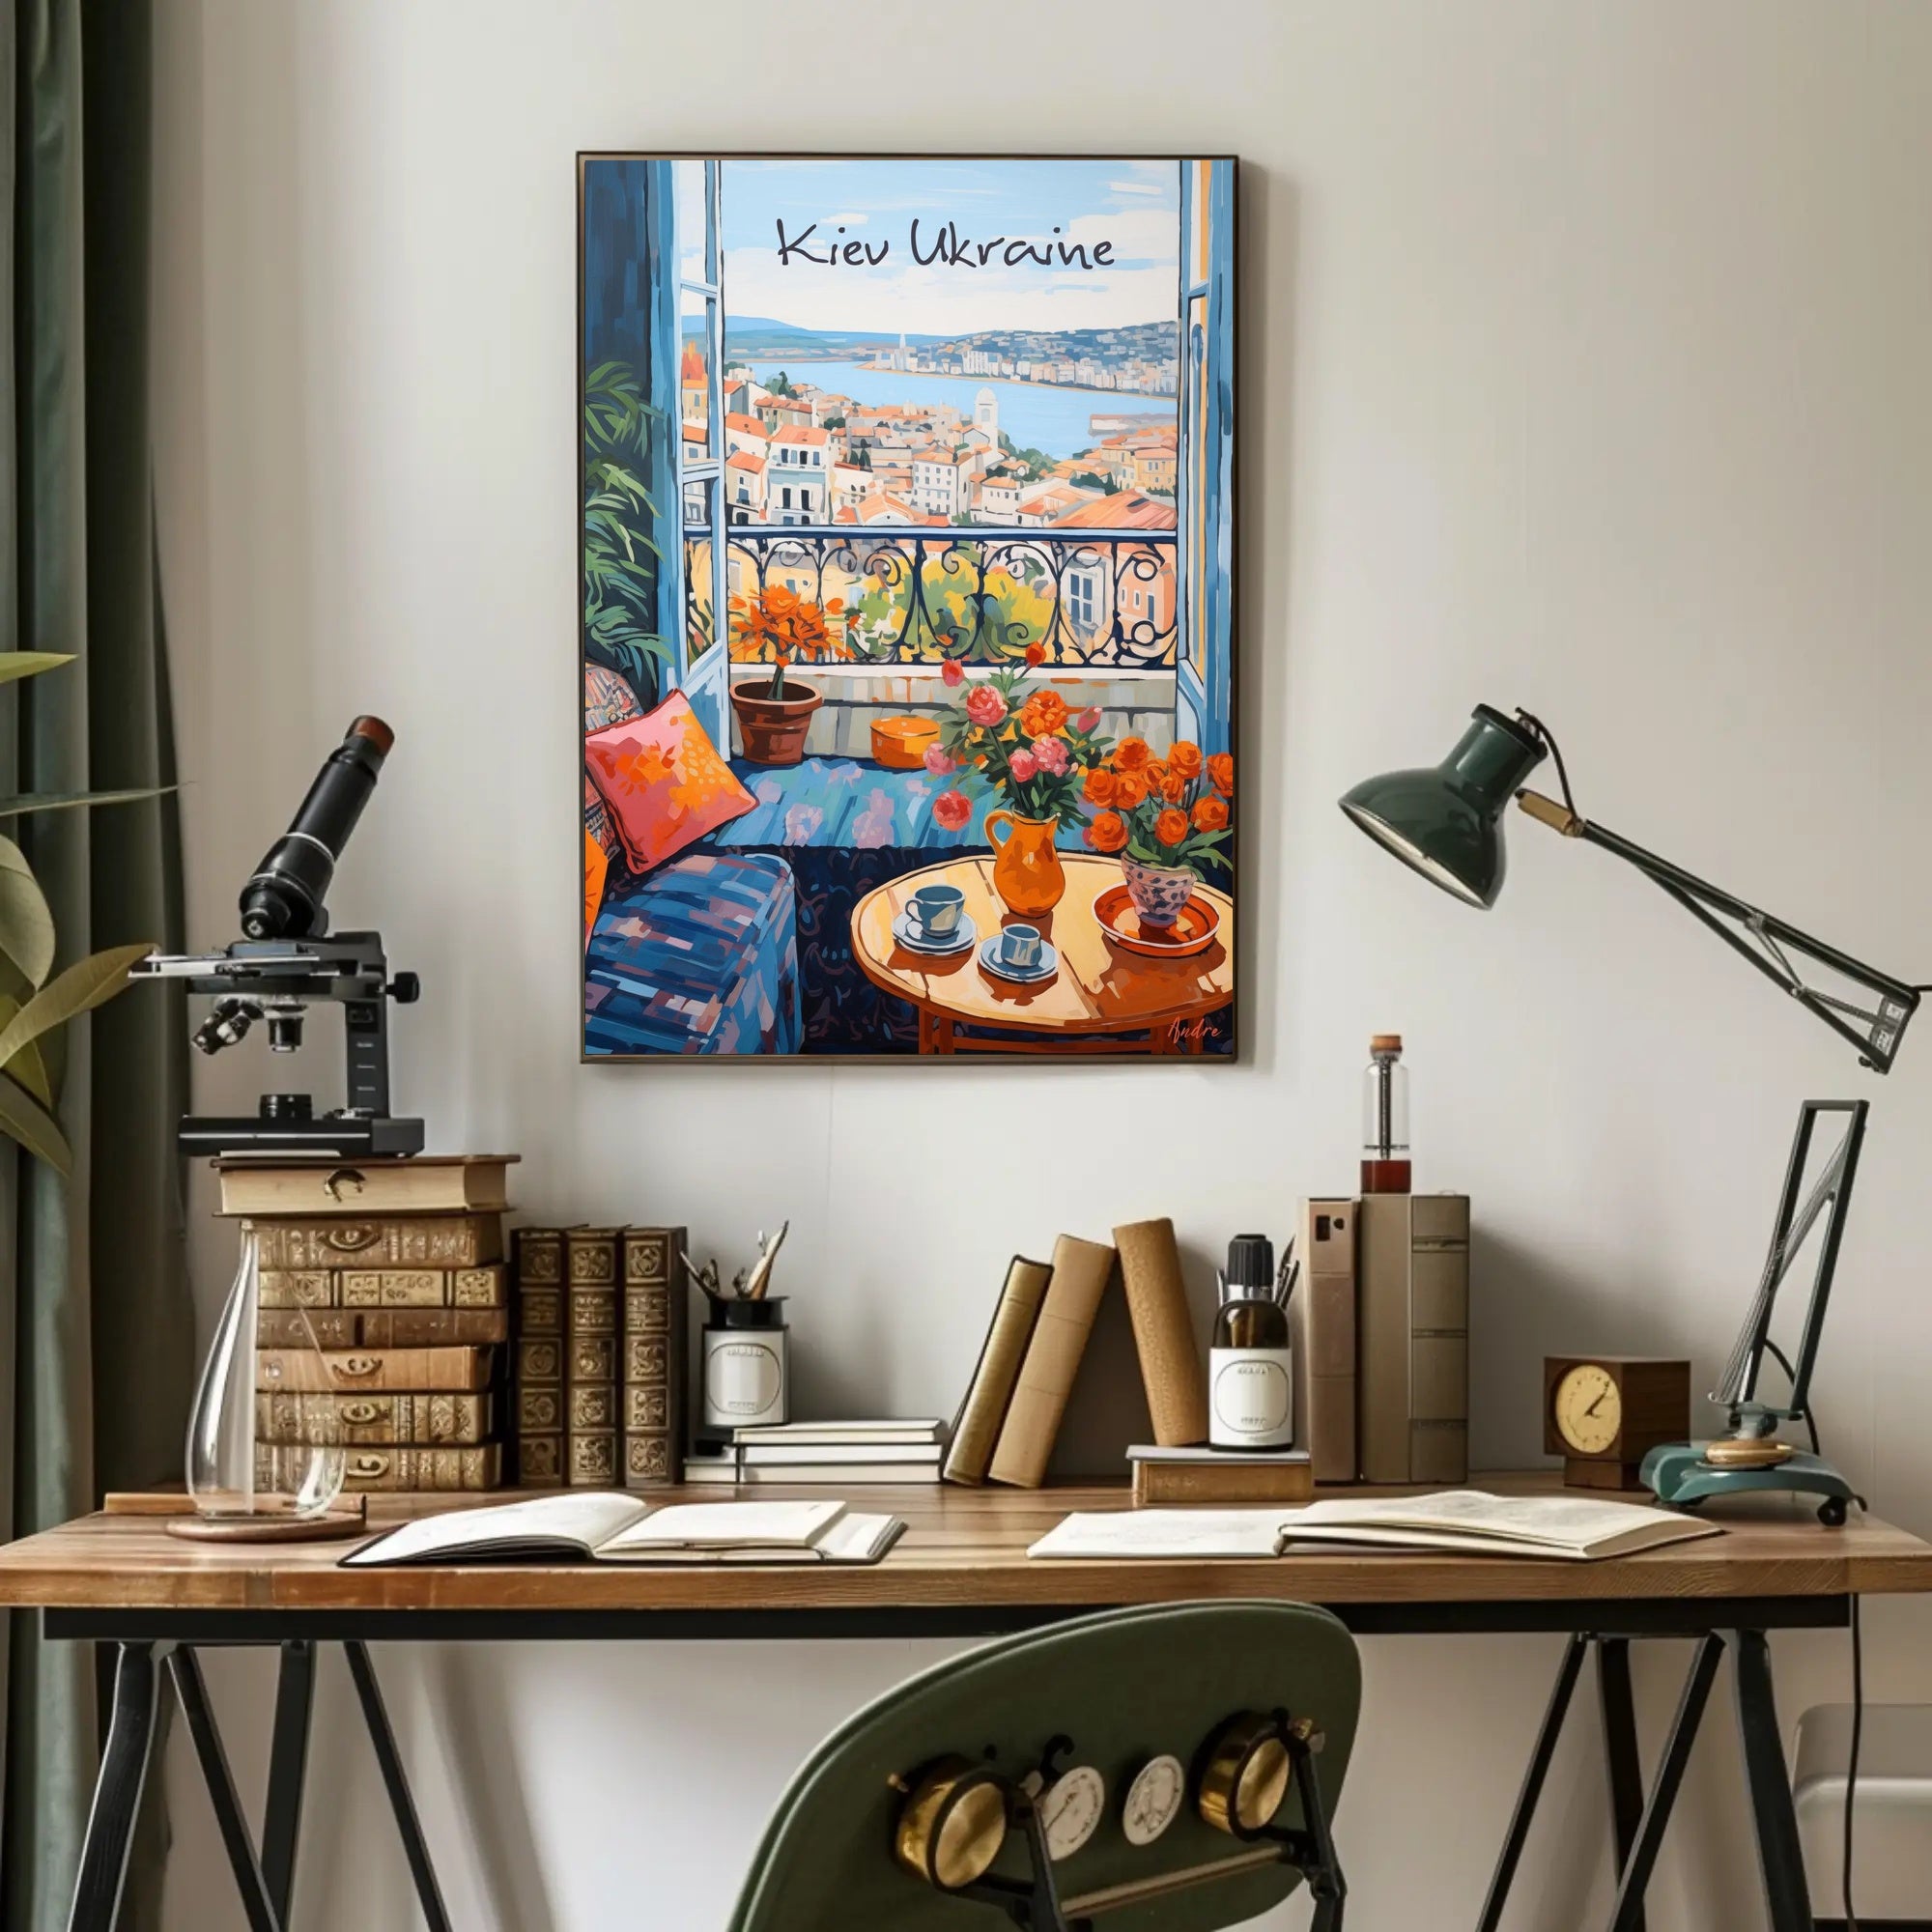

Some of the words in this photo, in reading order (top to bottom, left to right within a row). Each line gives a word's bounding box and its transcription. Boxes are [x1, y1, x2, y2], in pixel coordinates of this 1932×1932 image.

[777, 218, 888, 266] Kiev
[910, 218, 1114, 269] Ukraine
[1168, 1015, 1223, 1044] Andre
